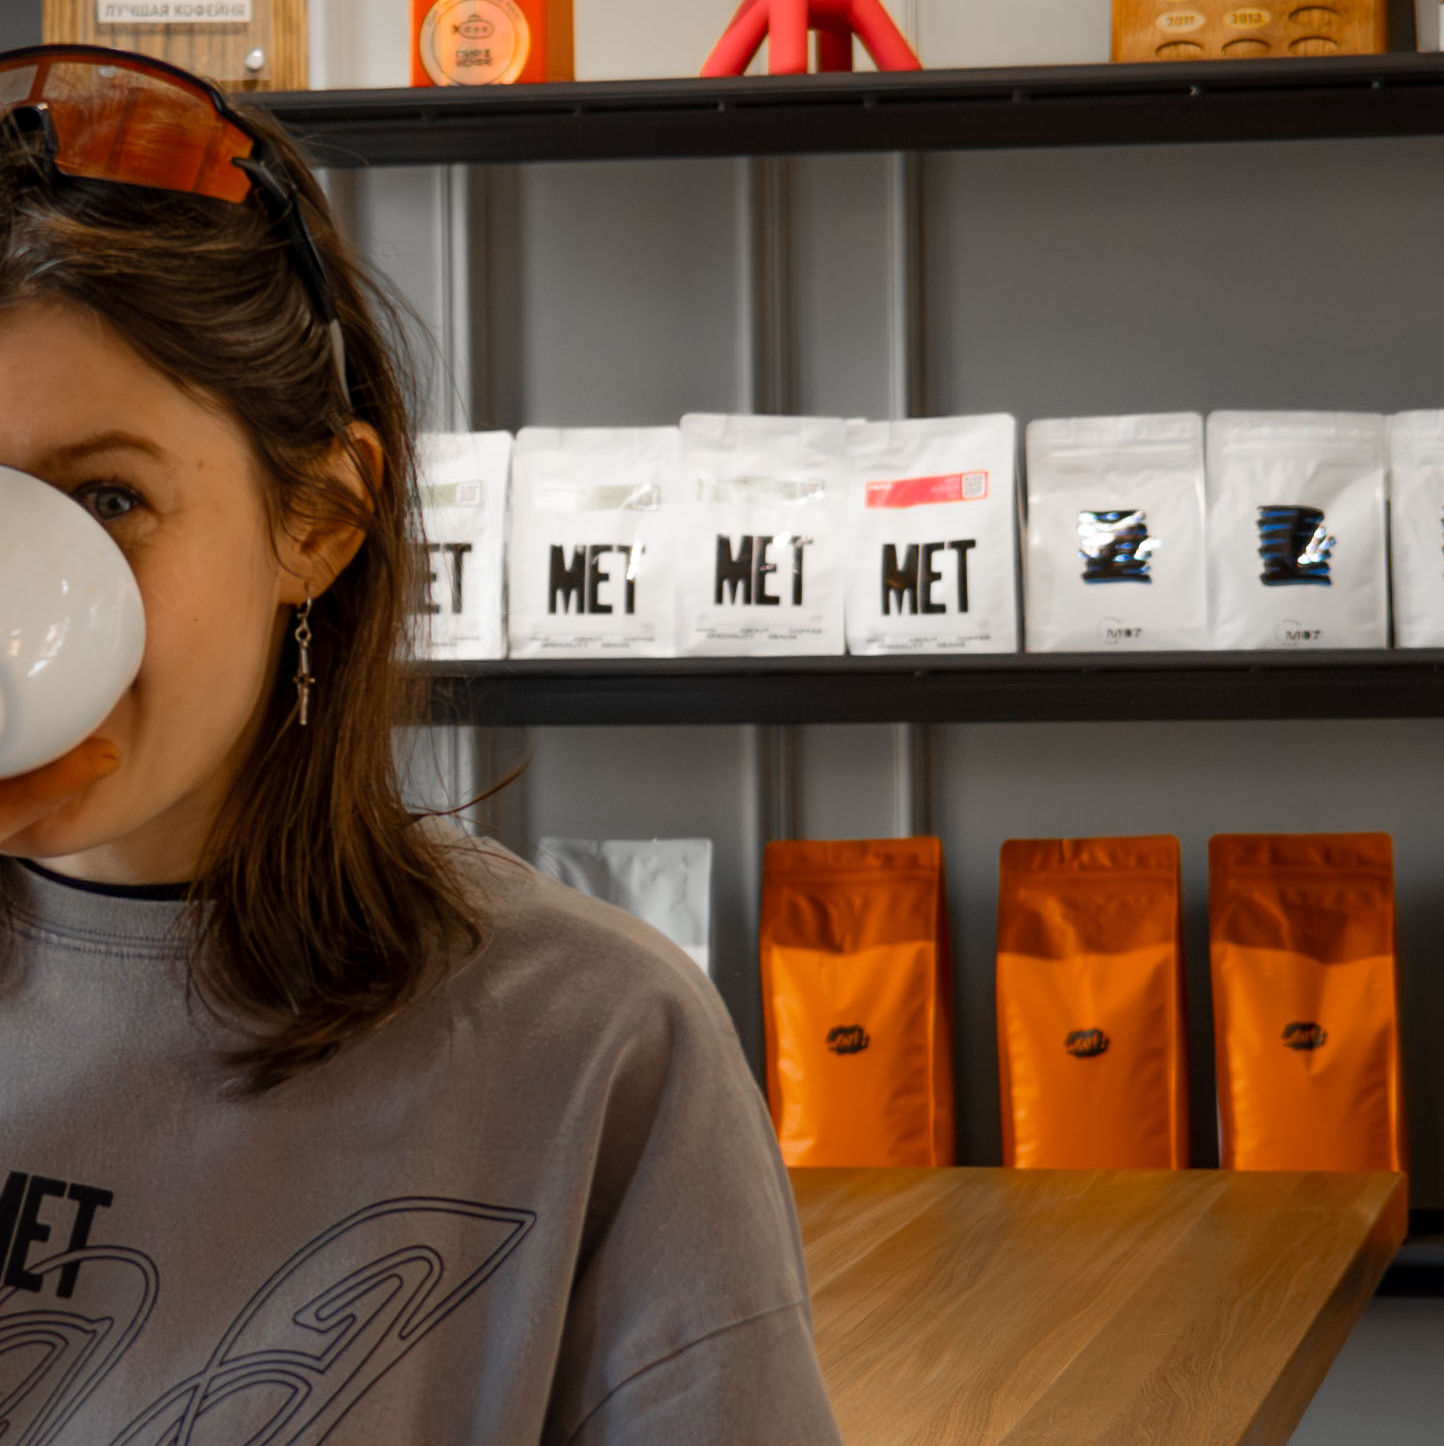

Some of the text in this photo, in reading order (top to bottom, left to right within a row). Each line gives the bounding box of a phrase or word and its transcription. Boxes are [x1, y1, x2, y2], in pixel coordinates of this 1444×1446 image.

[105, 1, 245, 18] ЛУЧШАЯ КОФЕЙНЯ
[410, 543, 473, 614] ET
[548, 544, 646, 615] MET
[715, 534, 813, 606] MET
[881, 539, 976, 616] MET
